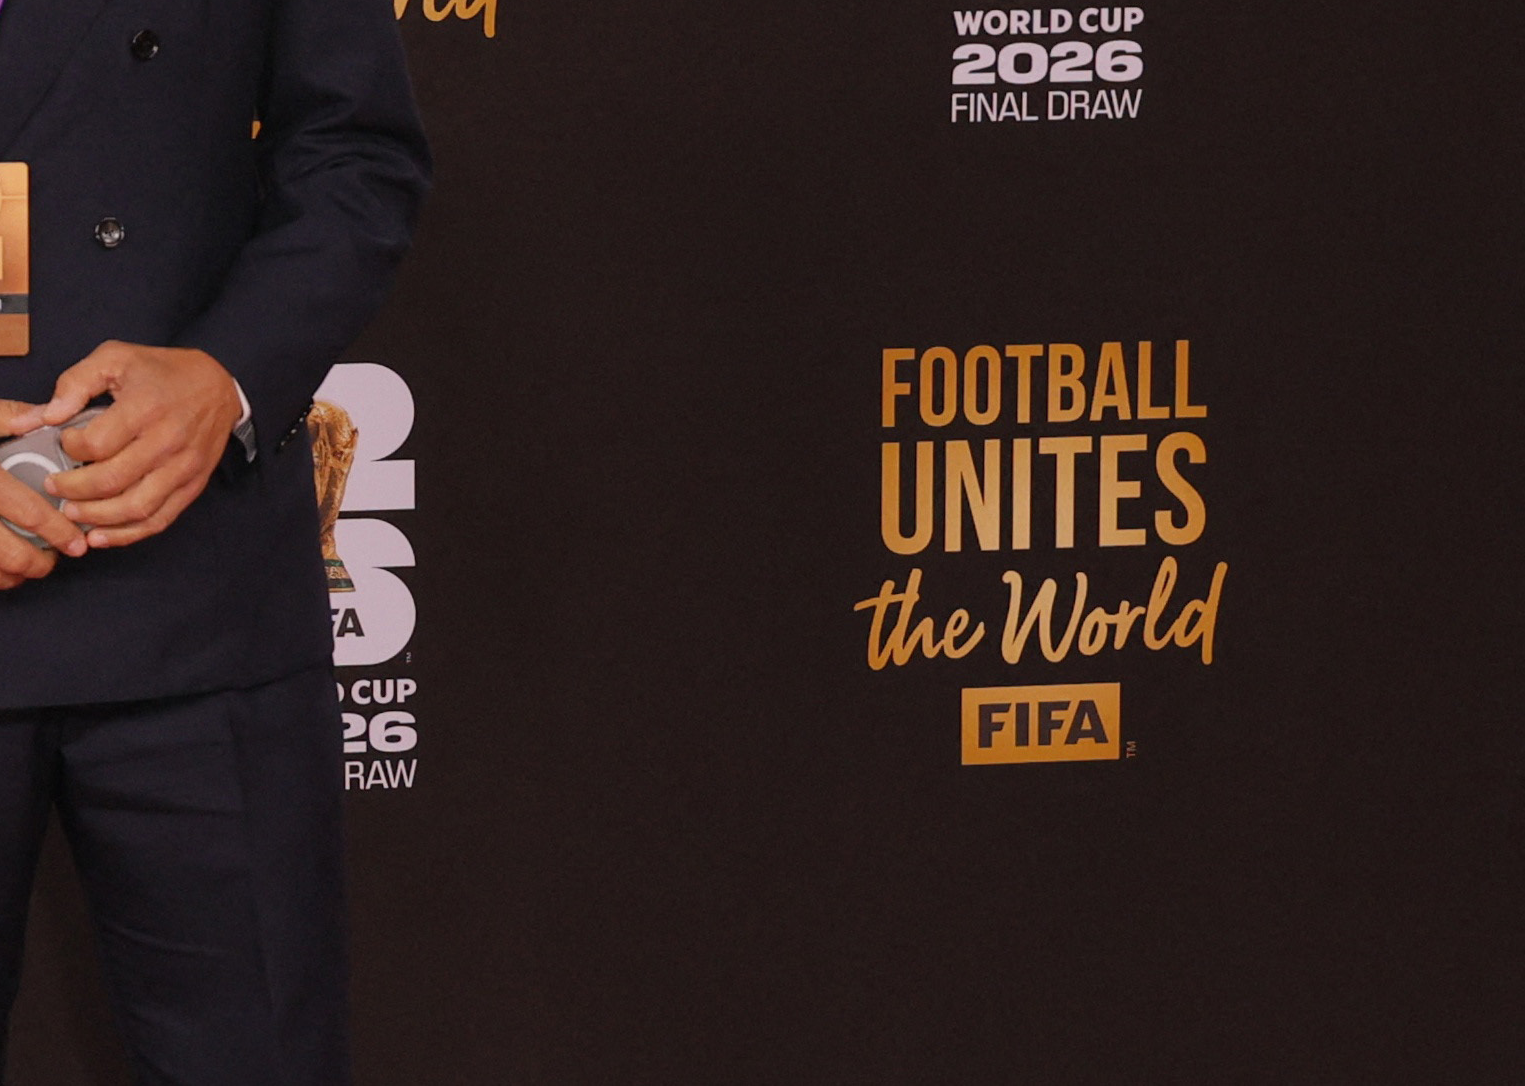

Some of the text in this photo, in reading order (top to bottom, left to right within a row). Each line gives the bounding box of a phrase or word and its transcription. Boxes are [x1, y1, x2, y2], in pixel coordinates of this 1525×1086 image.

[954, 7, 1144, 35] WORLD CUP
[952, 40, 1143, 84] 2026
[952, 89, 1142, 122] FINAL DRAW
[882, 340, 1207, 427] FOOTBALL
[882, 432, 1206, 555] UNITES
[854, 556, 1228, 671] the World
[351, 679, 416, 704] CUP
[341, 711, 417, 753] 26
[978, 700, 1109, 749] FIFA
[345, 759, 417, 790] RAW
